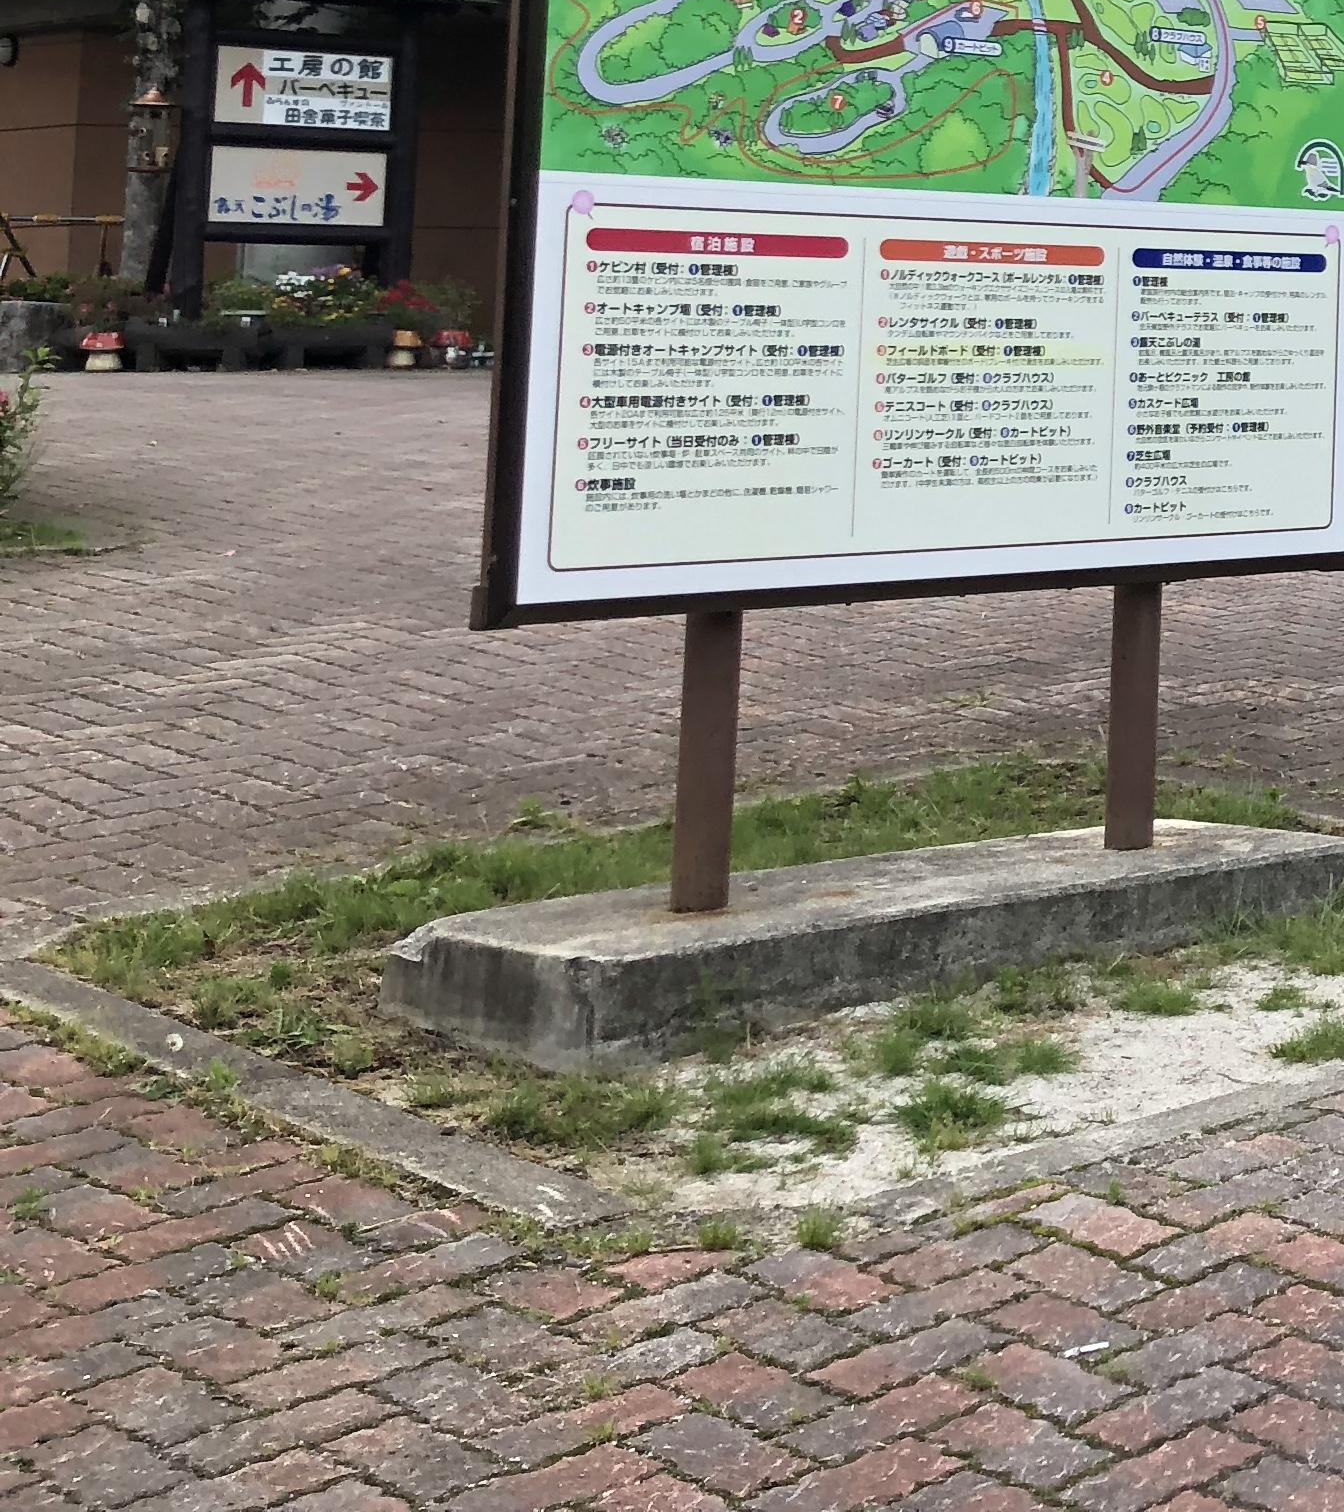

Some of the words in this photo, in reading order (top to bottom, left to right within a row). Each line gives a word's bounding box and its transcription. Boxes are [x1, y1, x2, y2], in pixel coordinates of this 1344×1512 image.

[269, 54, 384, 80] 工房の館
[279, 79, 388, 100] バーベキュー
